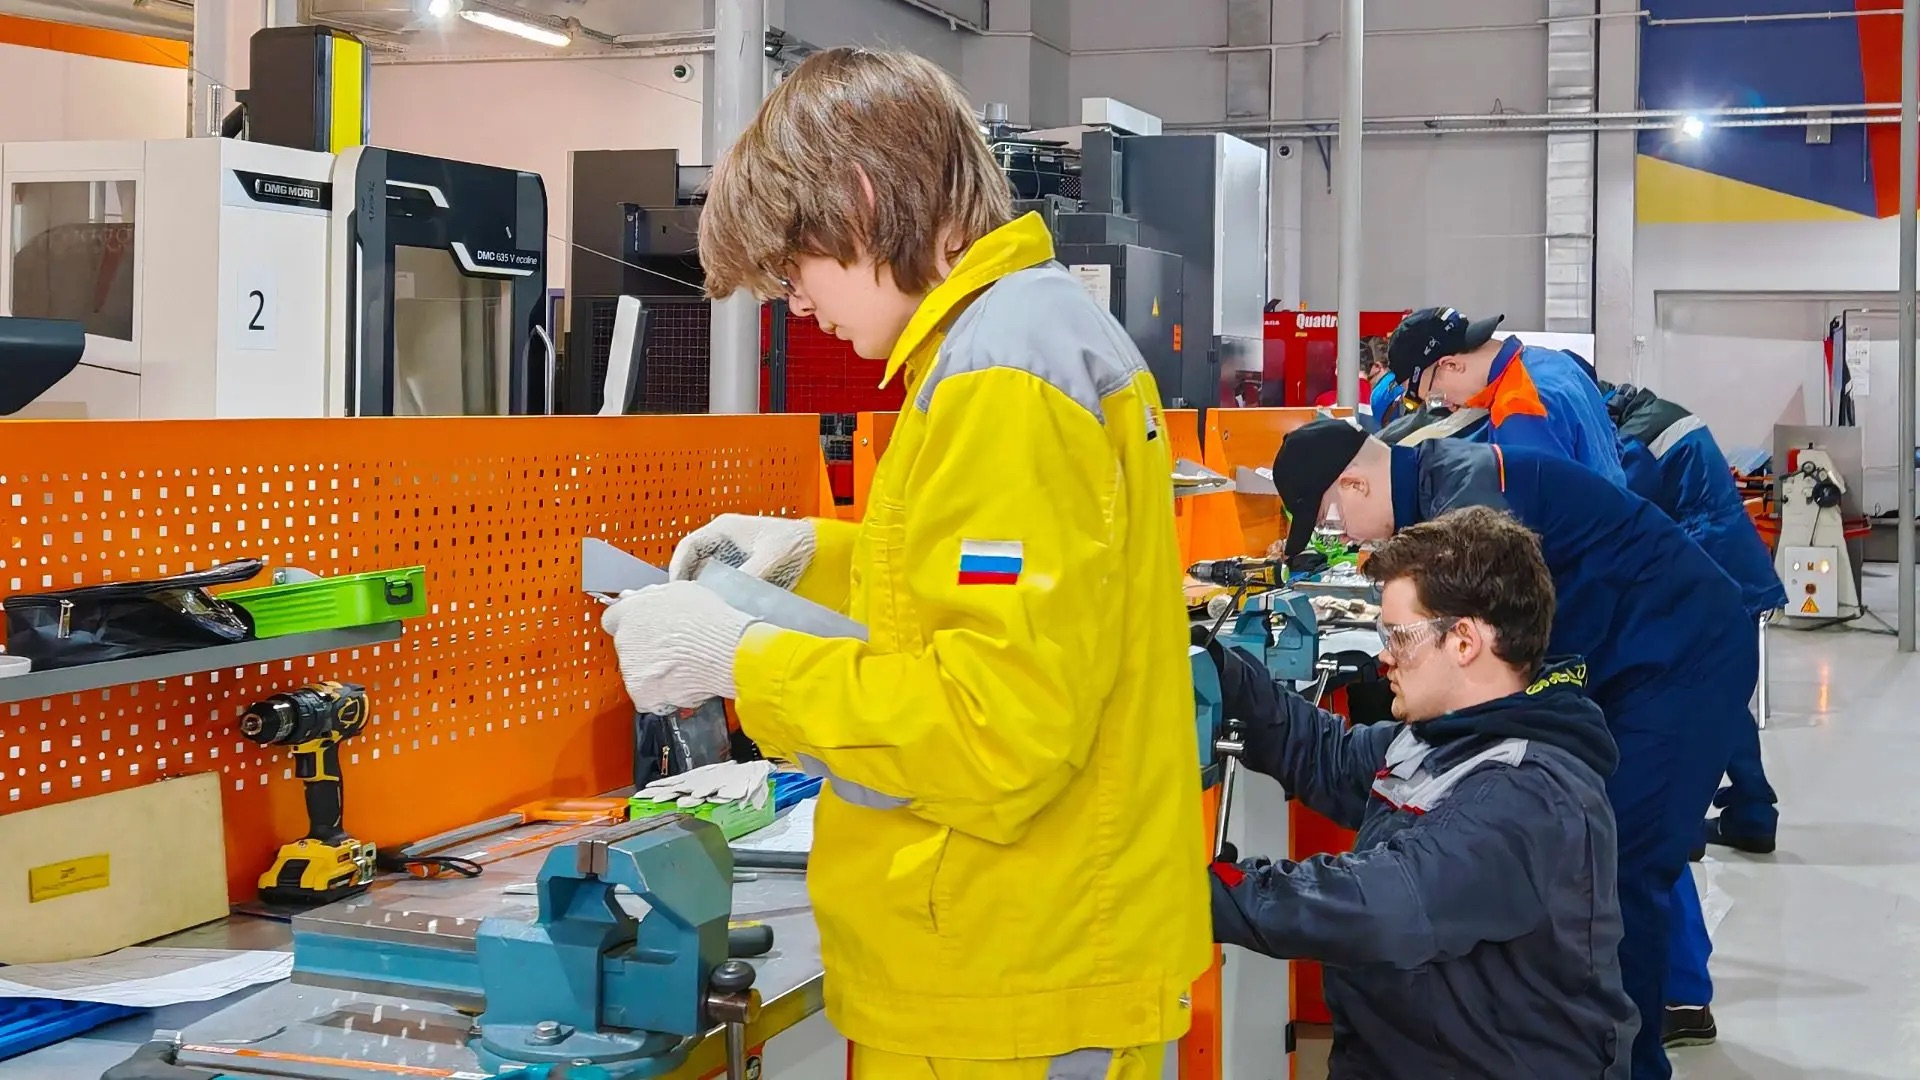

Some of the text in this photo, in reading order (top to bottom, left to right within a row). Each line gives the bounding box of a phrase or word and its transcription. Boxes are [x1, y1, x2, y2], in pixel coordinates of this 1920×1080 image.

[264, 183, 314, 198] DMG MORI
[477, 250, 495, 261] DMC
[496, 252, 509, 263] 635
[509, 254, 516, 263] V
[249, 290, 264, 330] 2
